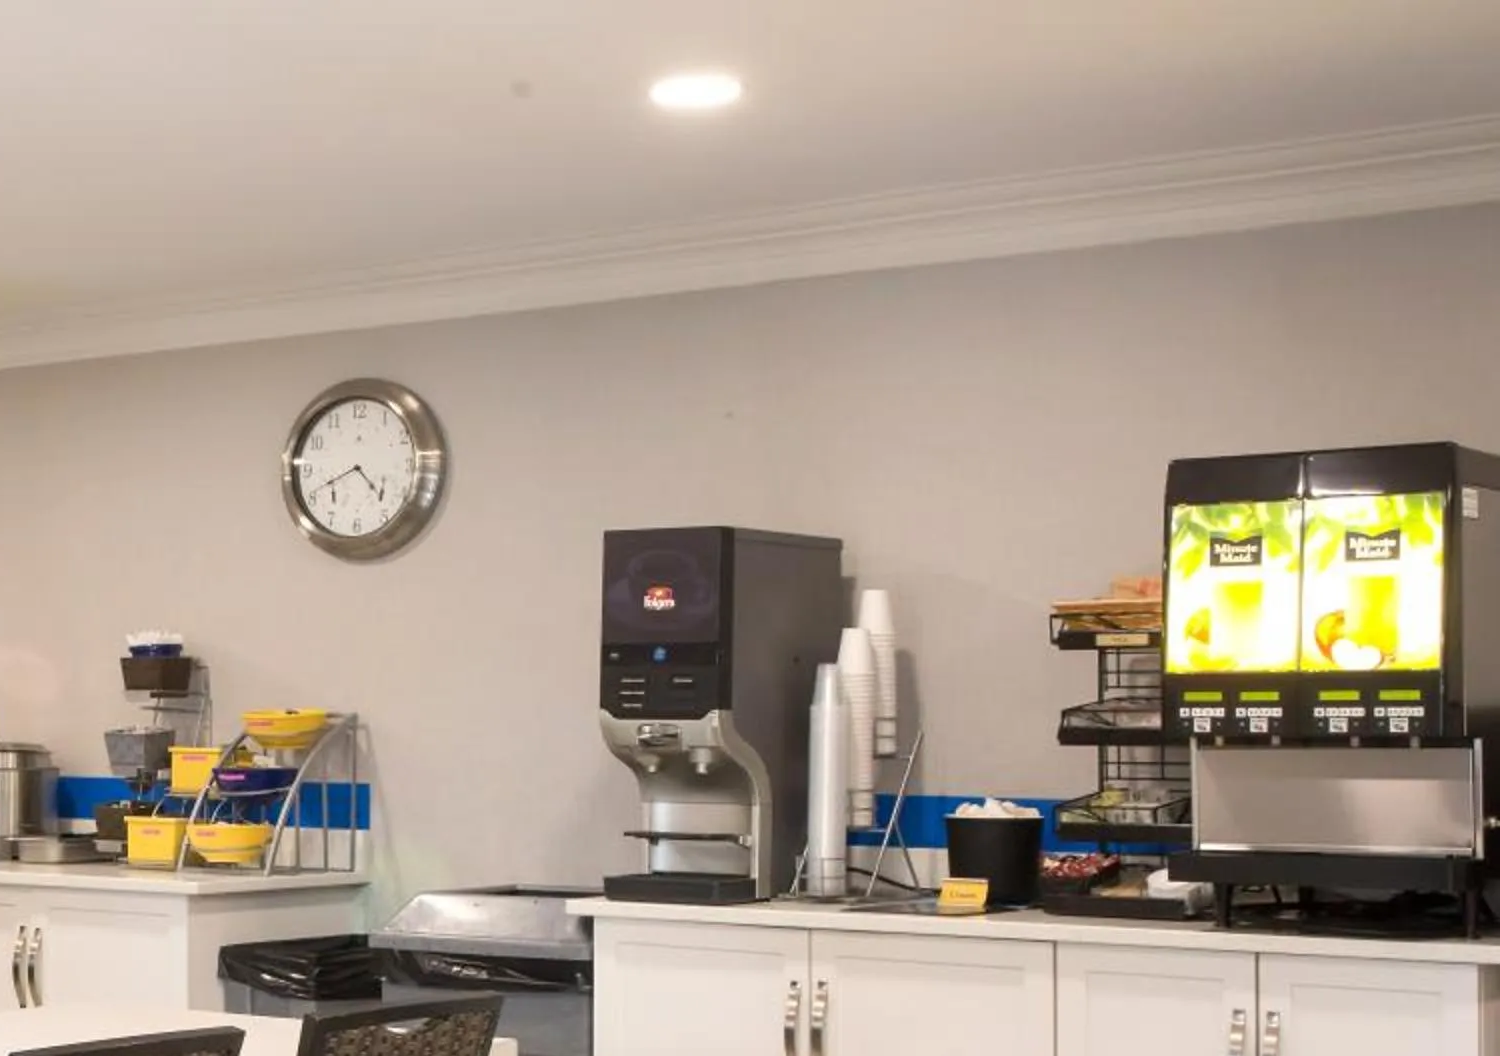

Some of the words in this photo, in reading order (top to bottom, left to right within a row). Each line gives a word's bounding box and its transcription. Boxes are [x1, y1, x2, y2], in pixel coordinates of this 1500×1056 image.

[353, 404, 367, 419] 12
[328, 413, 340, 429] 11
[310, 435, 323, 450] 10
[303, 463, 313, 478] 9
[327, 511, 336, 527] 7
[353, 519, 361, 533] 6
[1214, 543, 1258, 554] Minute
[1350, 537, 1396, 549] Minute
[1219, 552, 1252, 563] Maid
